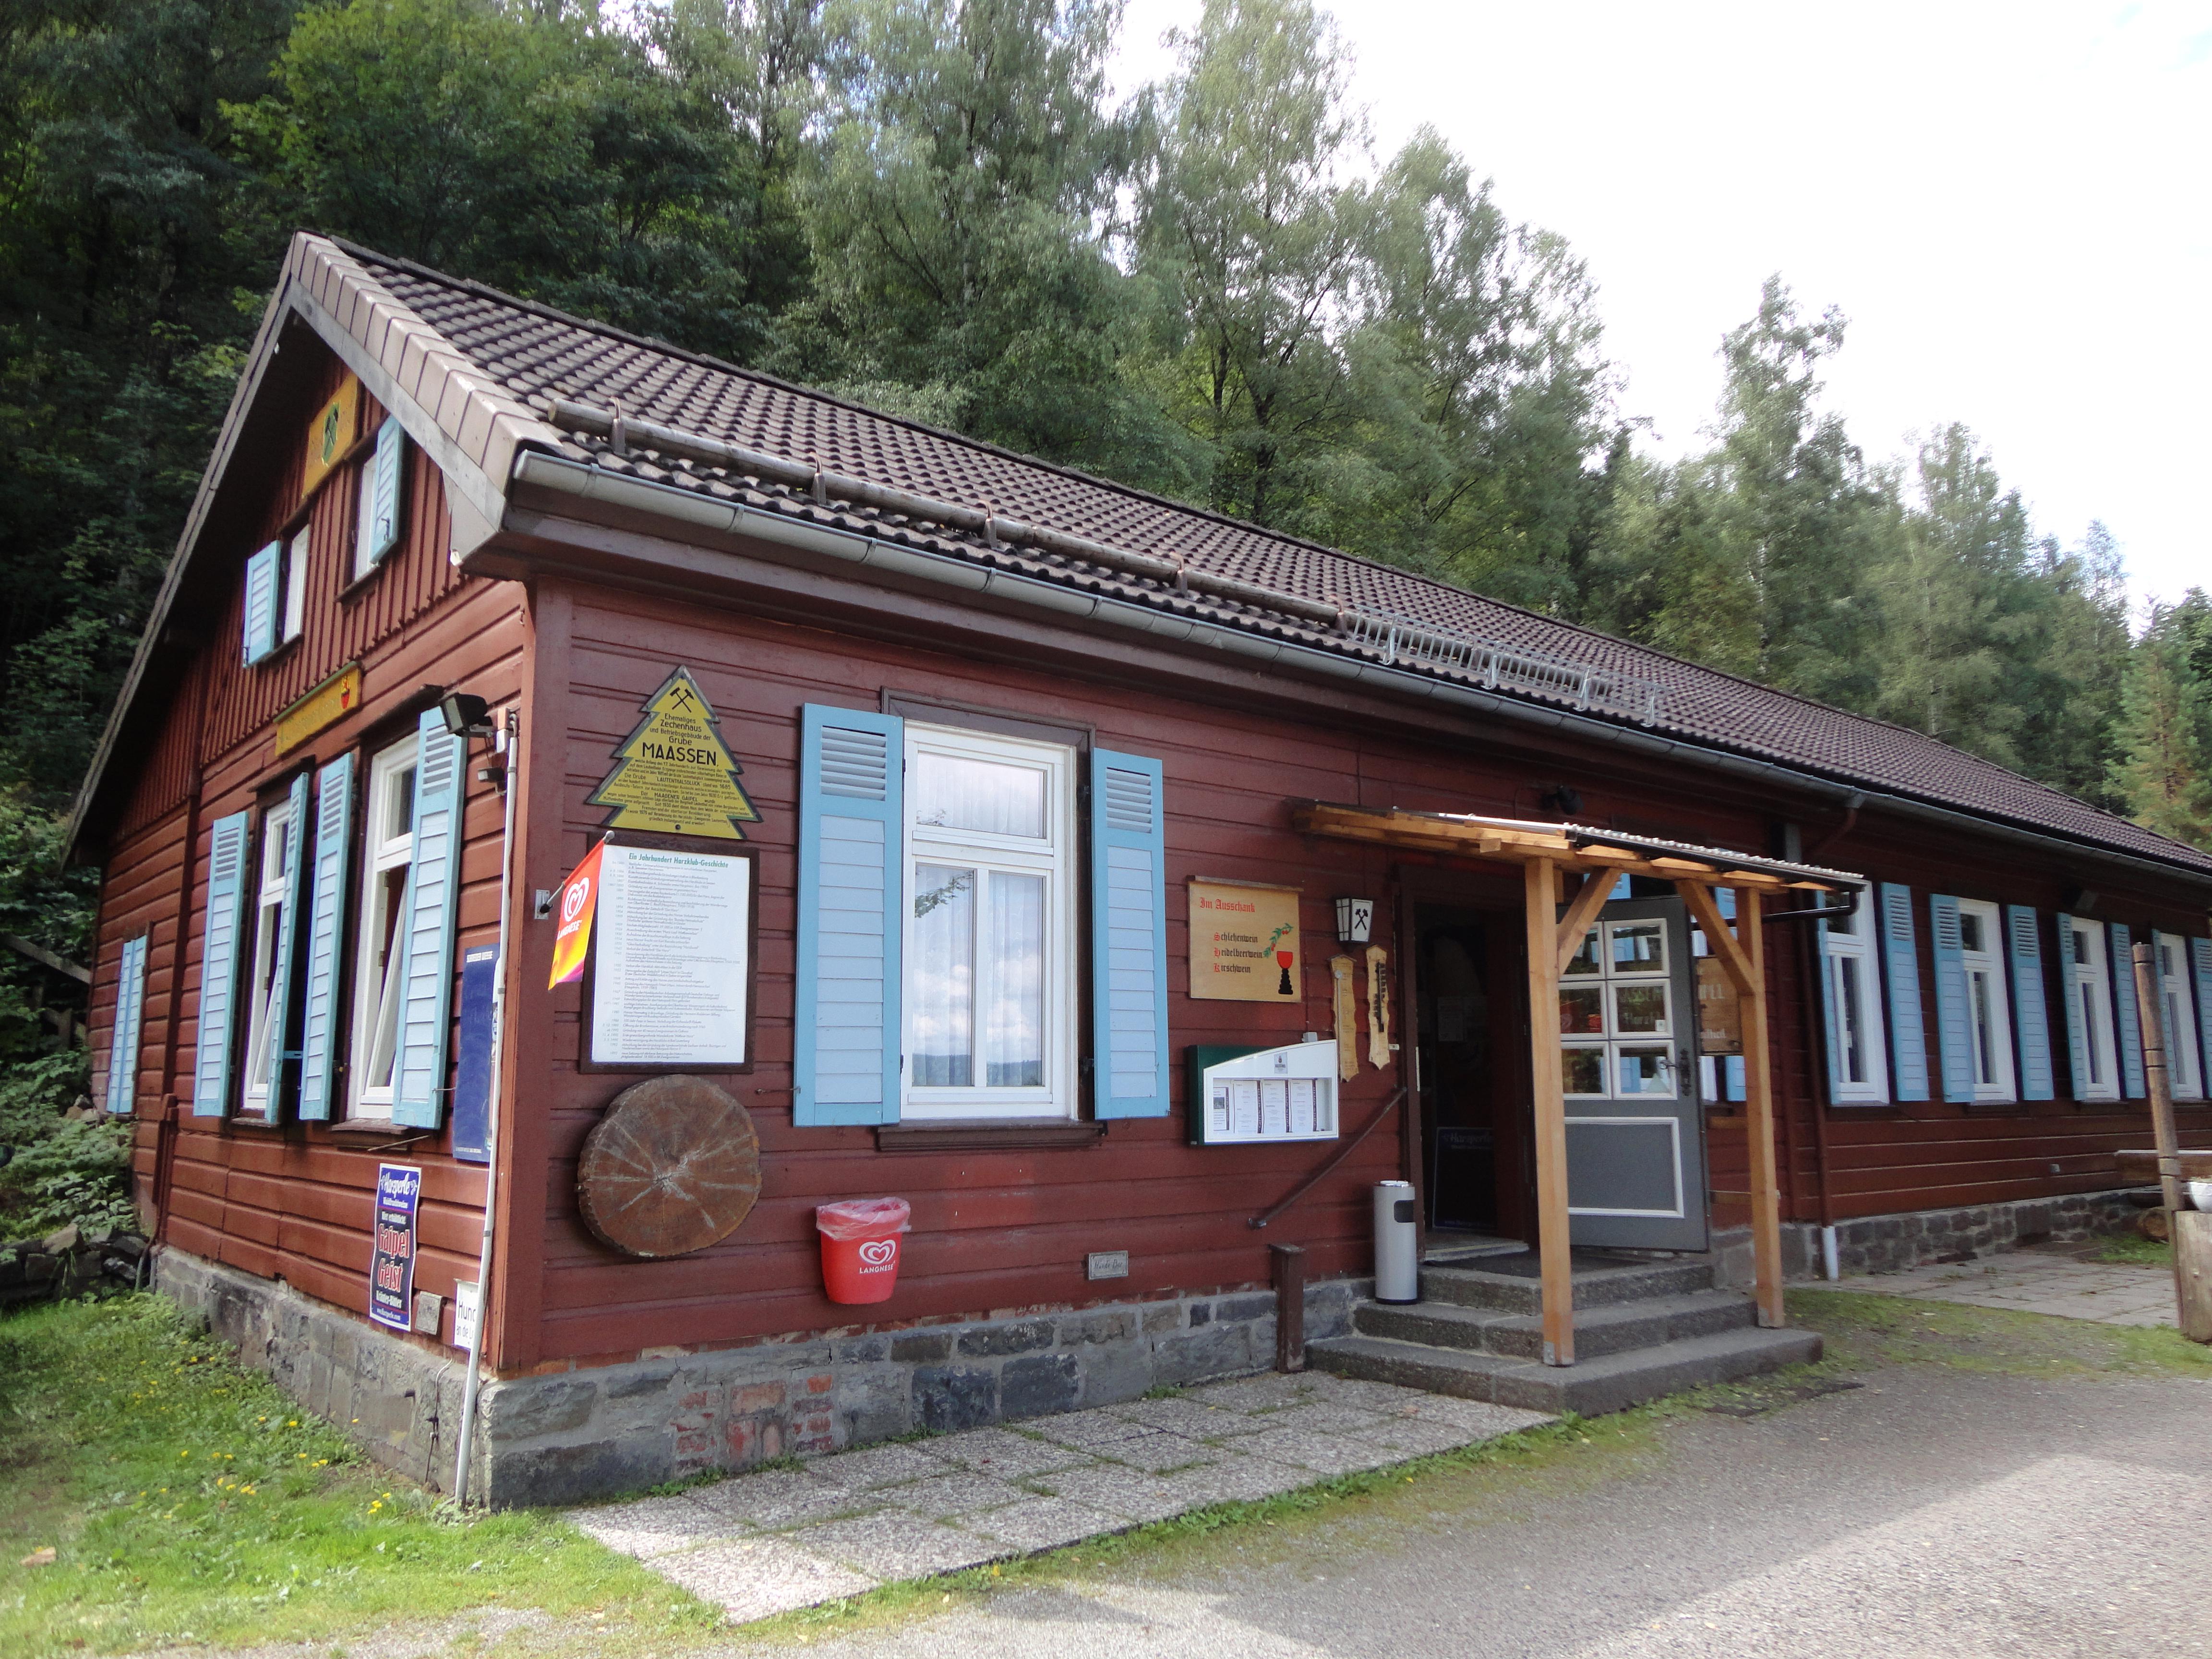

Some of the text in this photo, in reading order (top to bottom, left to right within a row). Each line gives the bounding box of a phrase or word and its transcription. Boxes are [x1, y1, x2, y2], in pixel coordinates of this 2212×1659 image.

[664, 713, 696, 724] Ehemaliges
[661, 719, 702, 732] Zechenhaus
[669, 736, 692, 745] Grube
[638, 854, 672, 864] Jahrhundert
[674, 857, 729, 868] Harzklub-Geschichte
[1200, 897, 1255, 912] Im Ausschank
[1214, 932, 1258, 943] Schlehenwein
[1214, 947, 1263, 959] Heidelbeerwein
[1214, 963, 1251, 974] Kirschwein
[378, 1223, 410, 1259] Gaipel
[859, 1263, 894, 1274] LANGNESE
[377, 1258, 403, 1293] Geist
